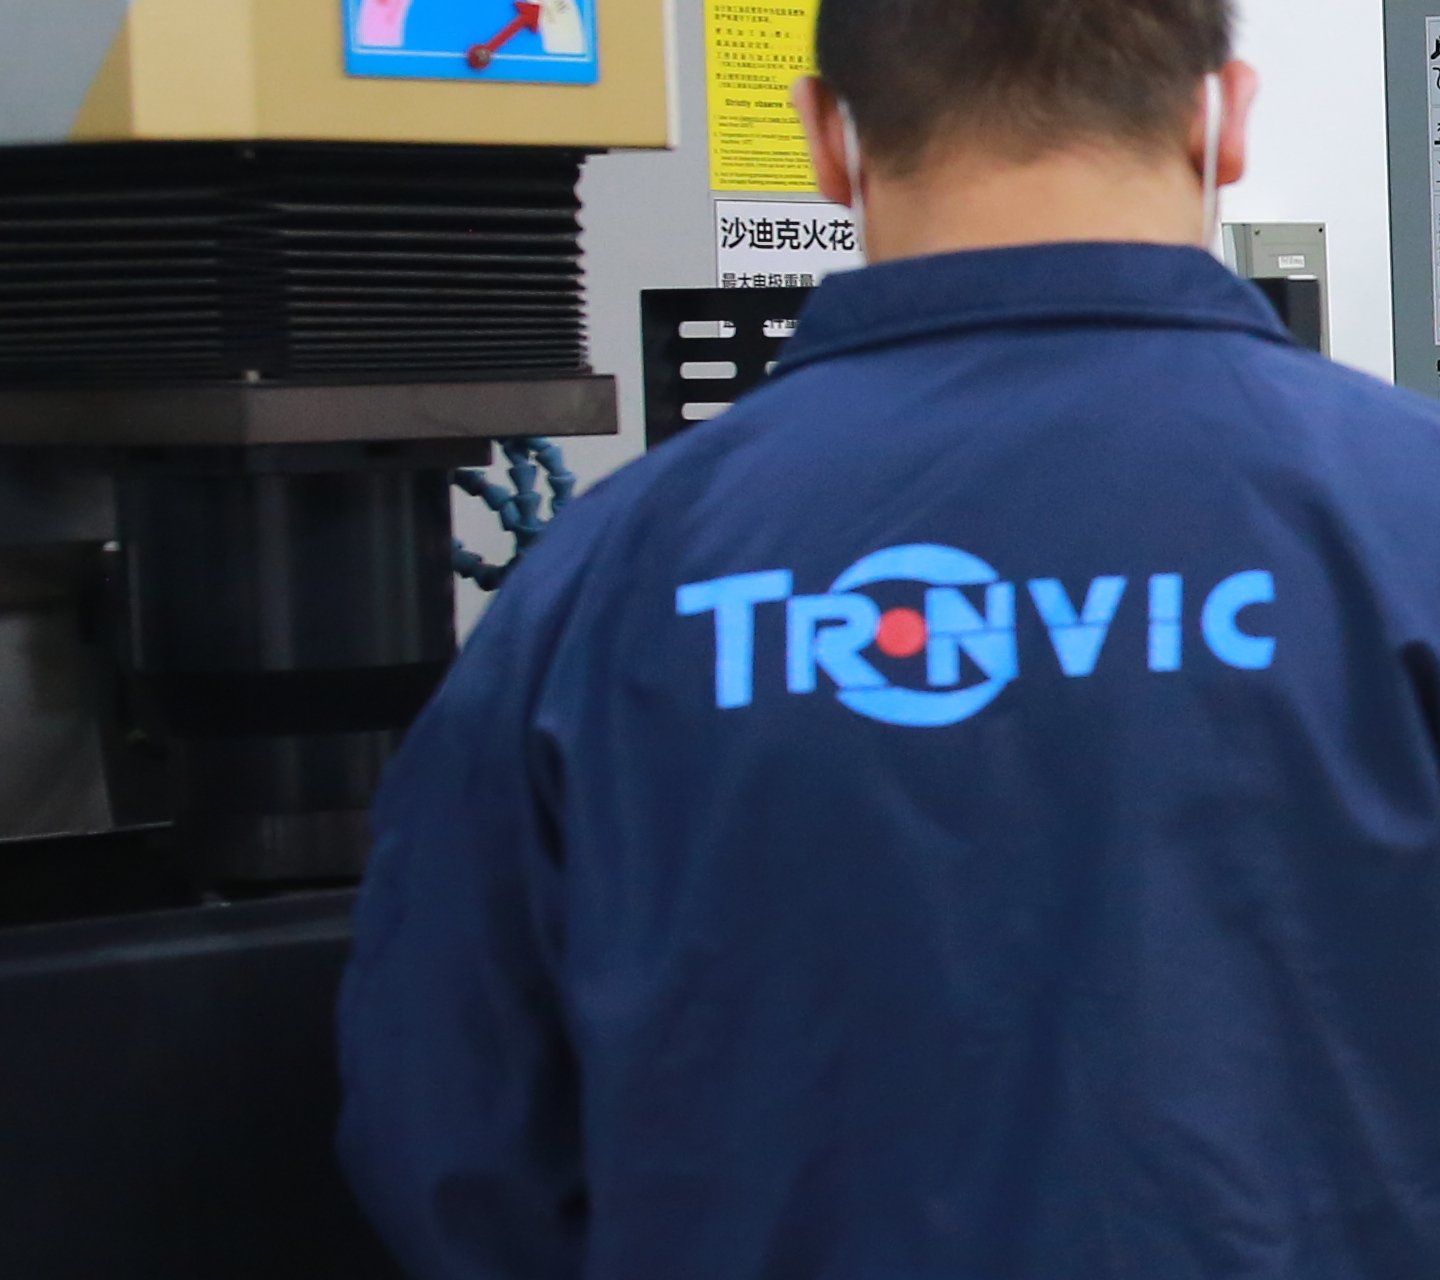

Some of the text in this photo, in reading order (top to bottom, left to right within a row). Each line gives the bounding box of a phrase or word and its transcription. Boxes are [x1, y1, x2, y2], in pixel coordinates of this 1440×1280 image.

[720, 216, 865, 252] 沙迪克火花
[674, 541, 1277, 728] TRONVIC
